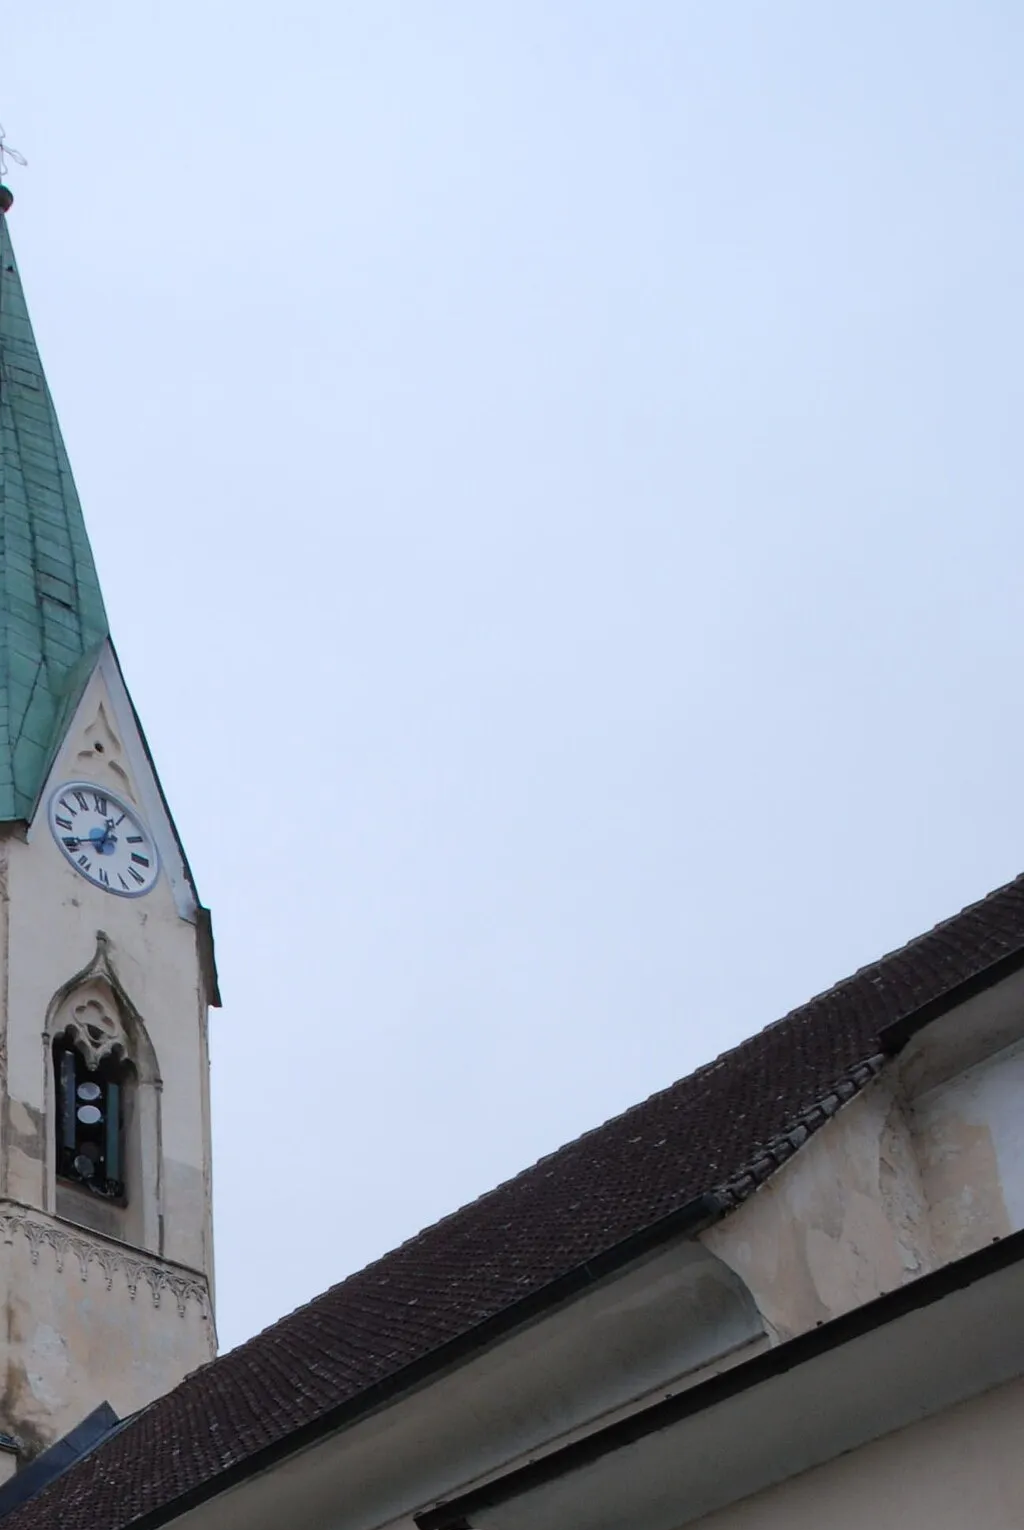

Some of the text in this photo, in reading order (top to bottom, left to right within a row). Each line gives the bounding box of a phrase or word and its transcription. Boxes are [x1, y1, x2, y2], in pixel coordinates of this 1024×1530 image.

[59, 798, 78, 817] X
[73, 791, 89, 811] XI
[93, 792, 107, 816] XII
[55, 814, 73, 831] IX
[115, 814, 127, 826] I
[77, 855, 92, 872] VII
[99, 868, 109, 886] VI
[117, 873, 130, 890] V
